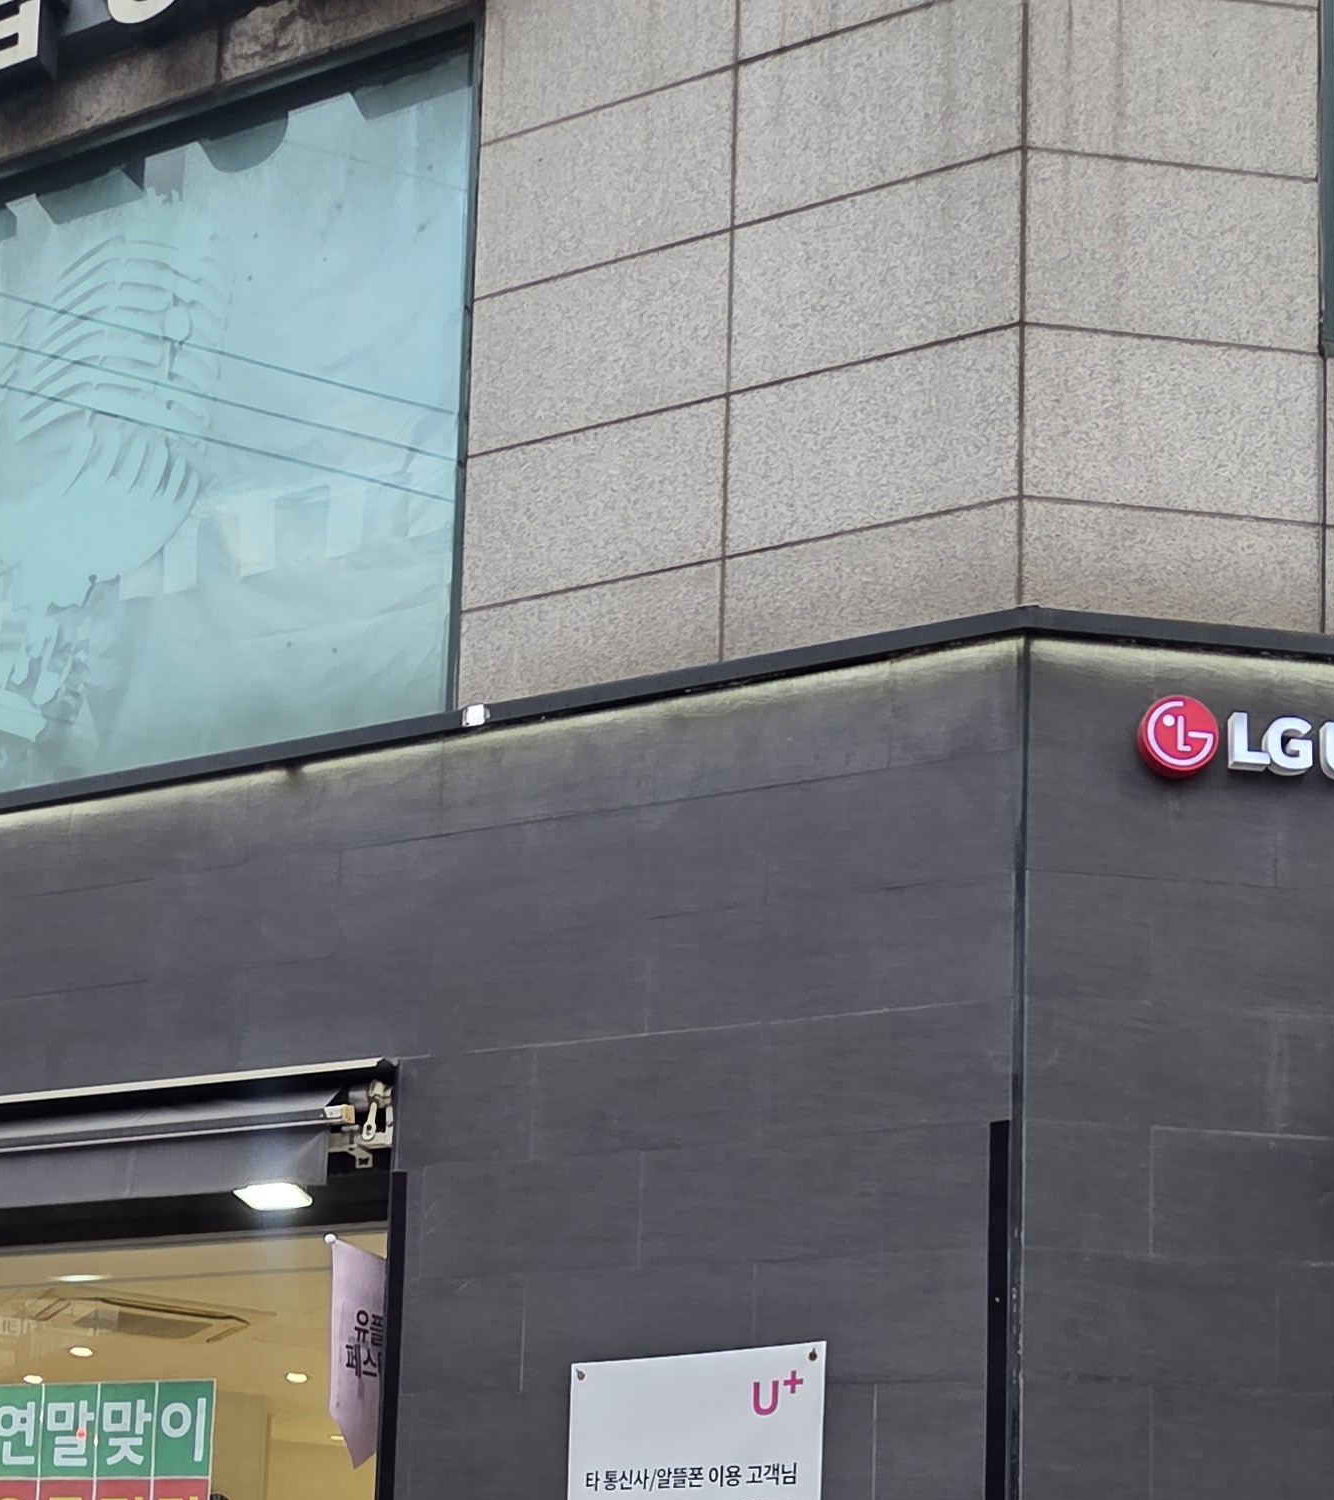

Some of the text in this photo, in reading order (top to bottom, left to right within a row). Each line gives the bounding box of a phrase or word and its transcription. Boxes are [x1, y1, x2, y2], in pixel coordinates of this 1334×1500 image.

[752, 1370, 803, 1415] U+
[586, 1462, 798, 1491] 타 통신사/알뜰폰 이용 고객님
